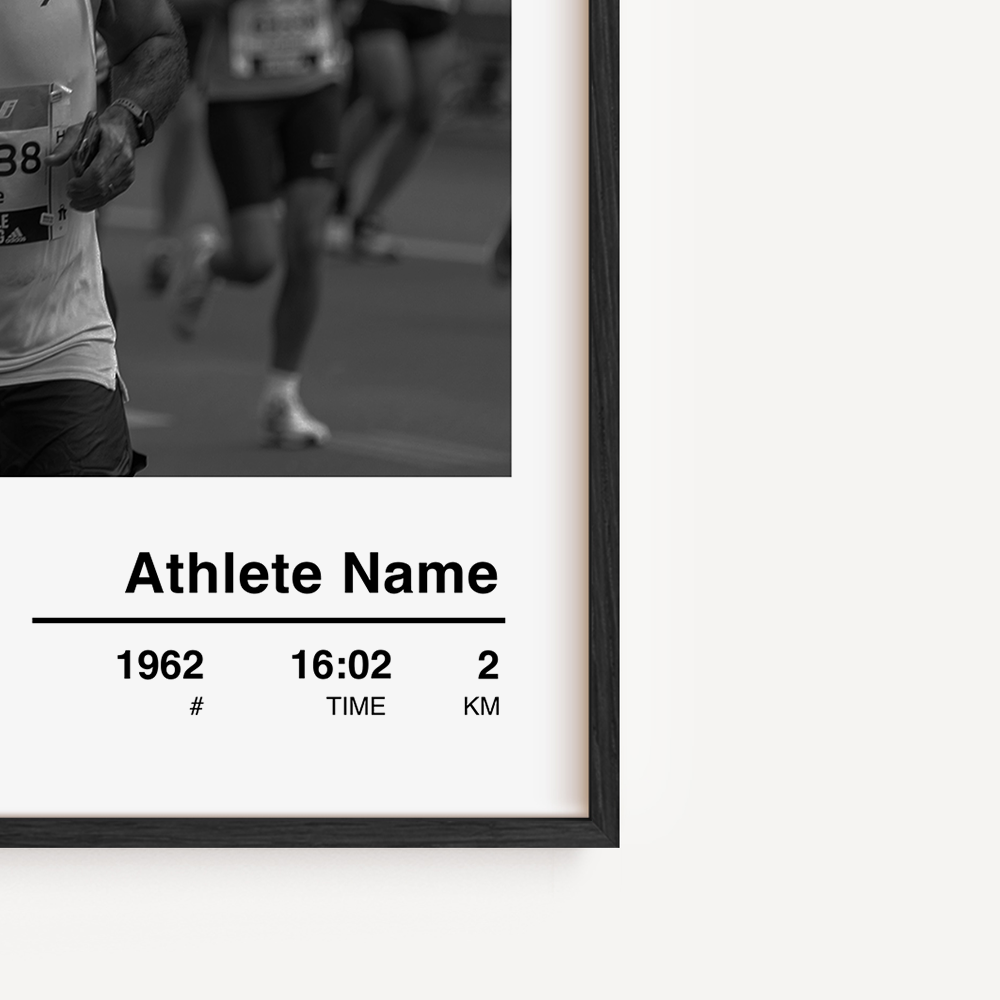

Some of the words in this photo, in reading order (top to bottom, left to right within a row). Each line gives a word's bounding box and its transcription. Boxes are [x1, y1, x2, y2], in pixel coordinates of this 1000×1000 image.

[124, 551, 322, 595] Athlete
[344, 551, 498, 595] Name
[116, 649, 204, 680] 1962
[291, 649, 392, 680] 16:02
[477, 649, 499, 680] 2
[189, 696, 205, 716] #
[326, 696, 386, 716] TIME
[464, 696, 500, 716] KM
